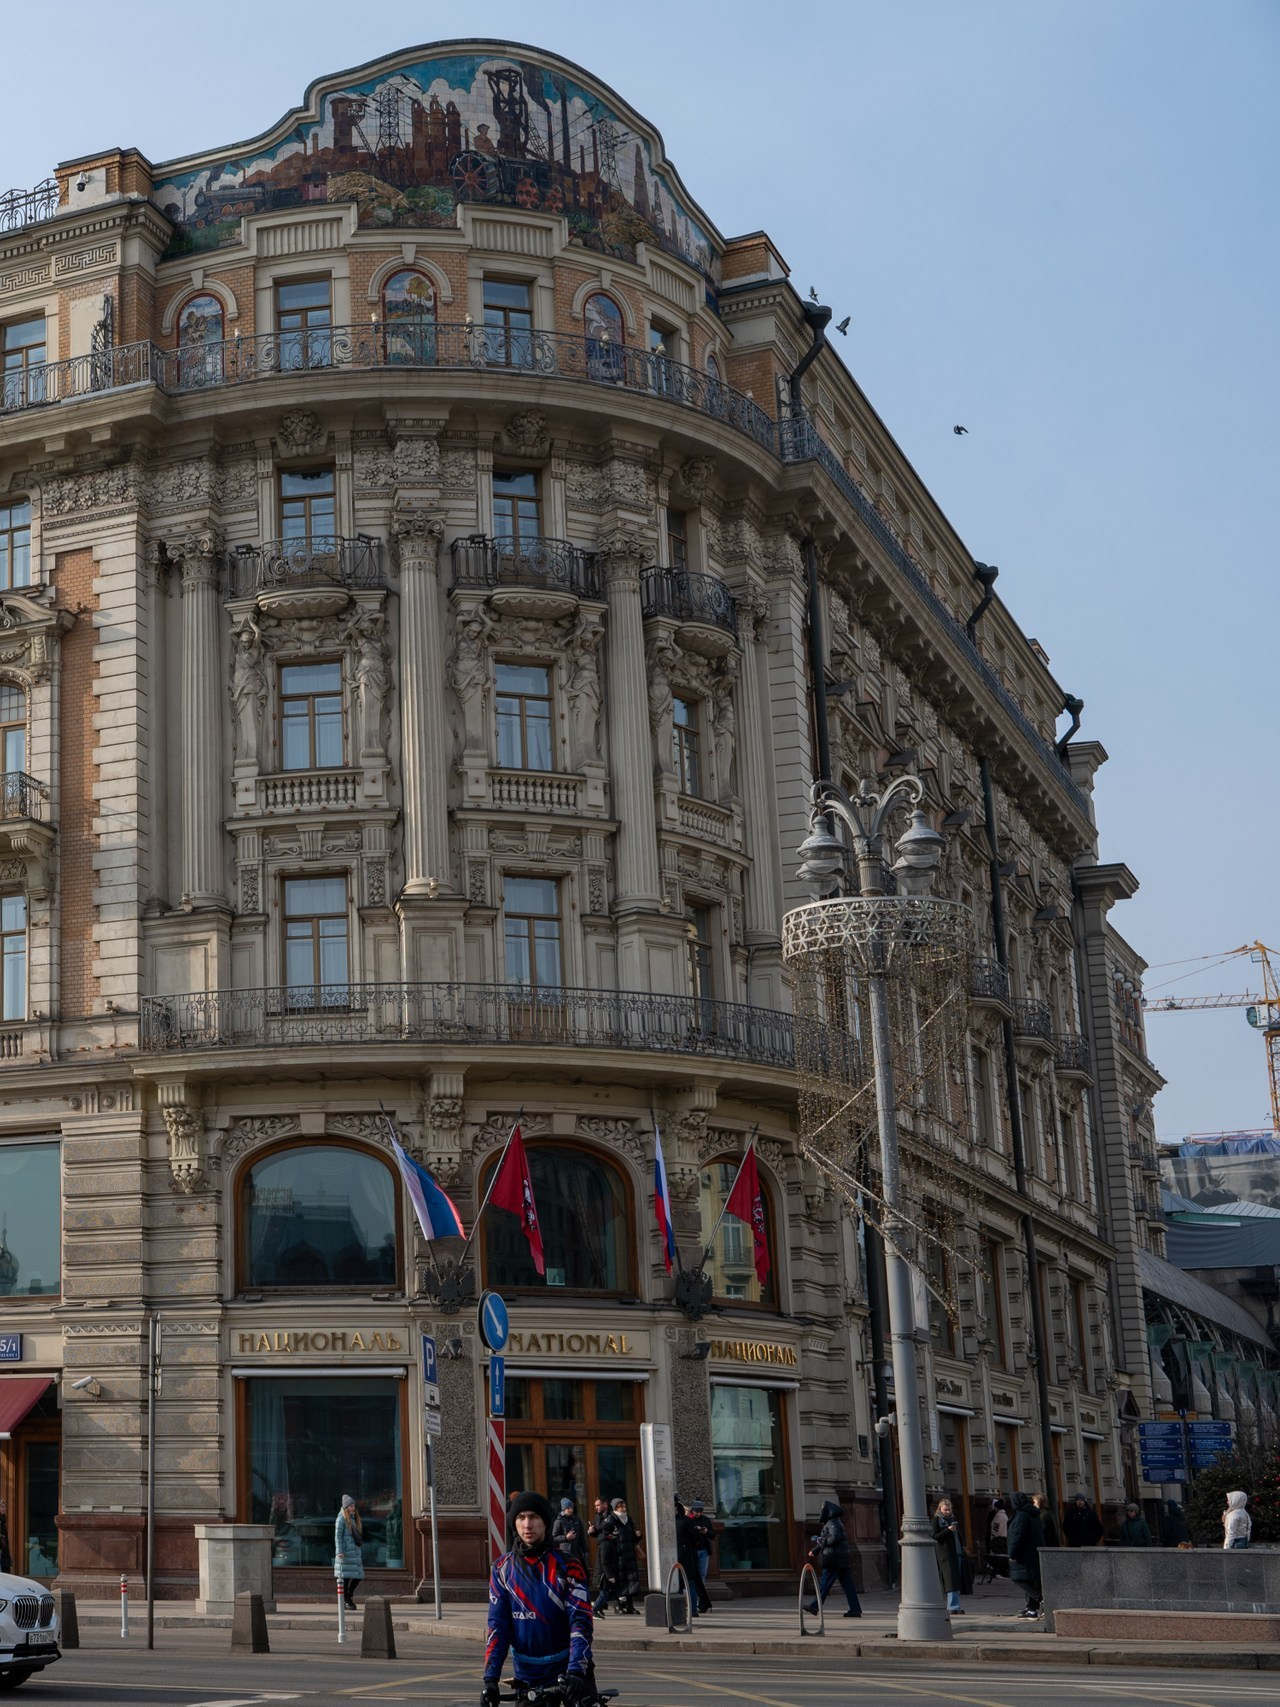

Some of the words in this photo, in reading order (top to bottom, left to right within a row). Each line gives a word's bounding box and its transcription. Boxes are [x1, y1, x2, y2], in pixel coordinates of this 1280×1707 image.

[238, 1331, 401, 1353] НАЦИОНАЛЬ
[508, 1333, 633, 1354] NATIONAL
[711, 1340, 797, 1365] НАЦИОНАЛЬ
